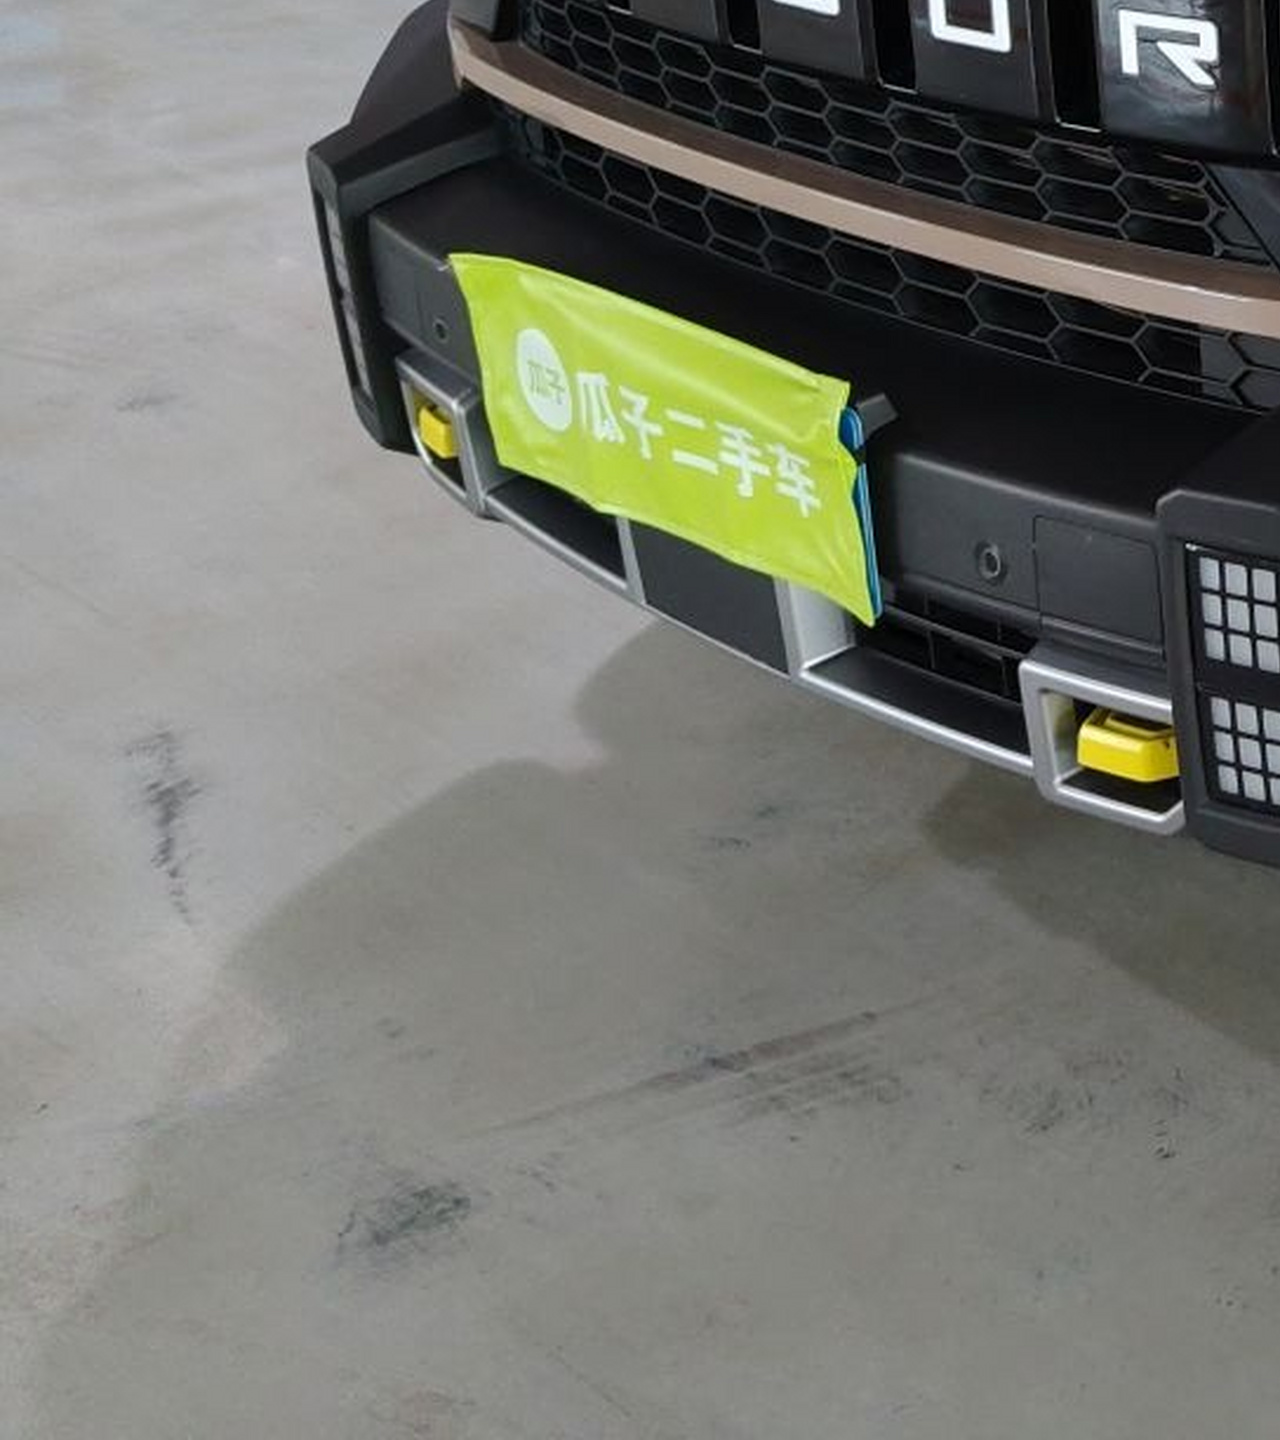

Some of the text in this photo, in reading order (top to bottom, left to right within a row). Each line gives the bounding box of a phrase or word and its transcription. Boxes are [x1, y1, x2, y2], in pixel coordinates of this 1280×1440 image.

[527, 359, 566, 406] 瓜子
[576, 371, 822, 518] 瓜子二手车
